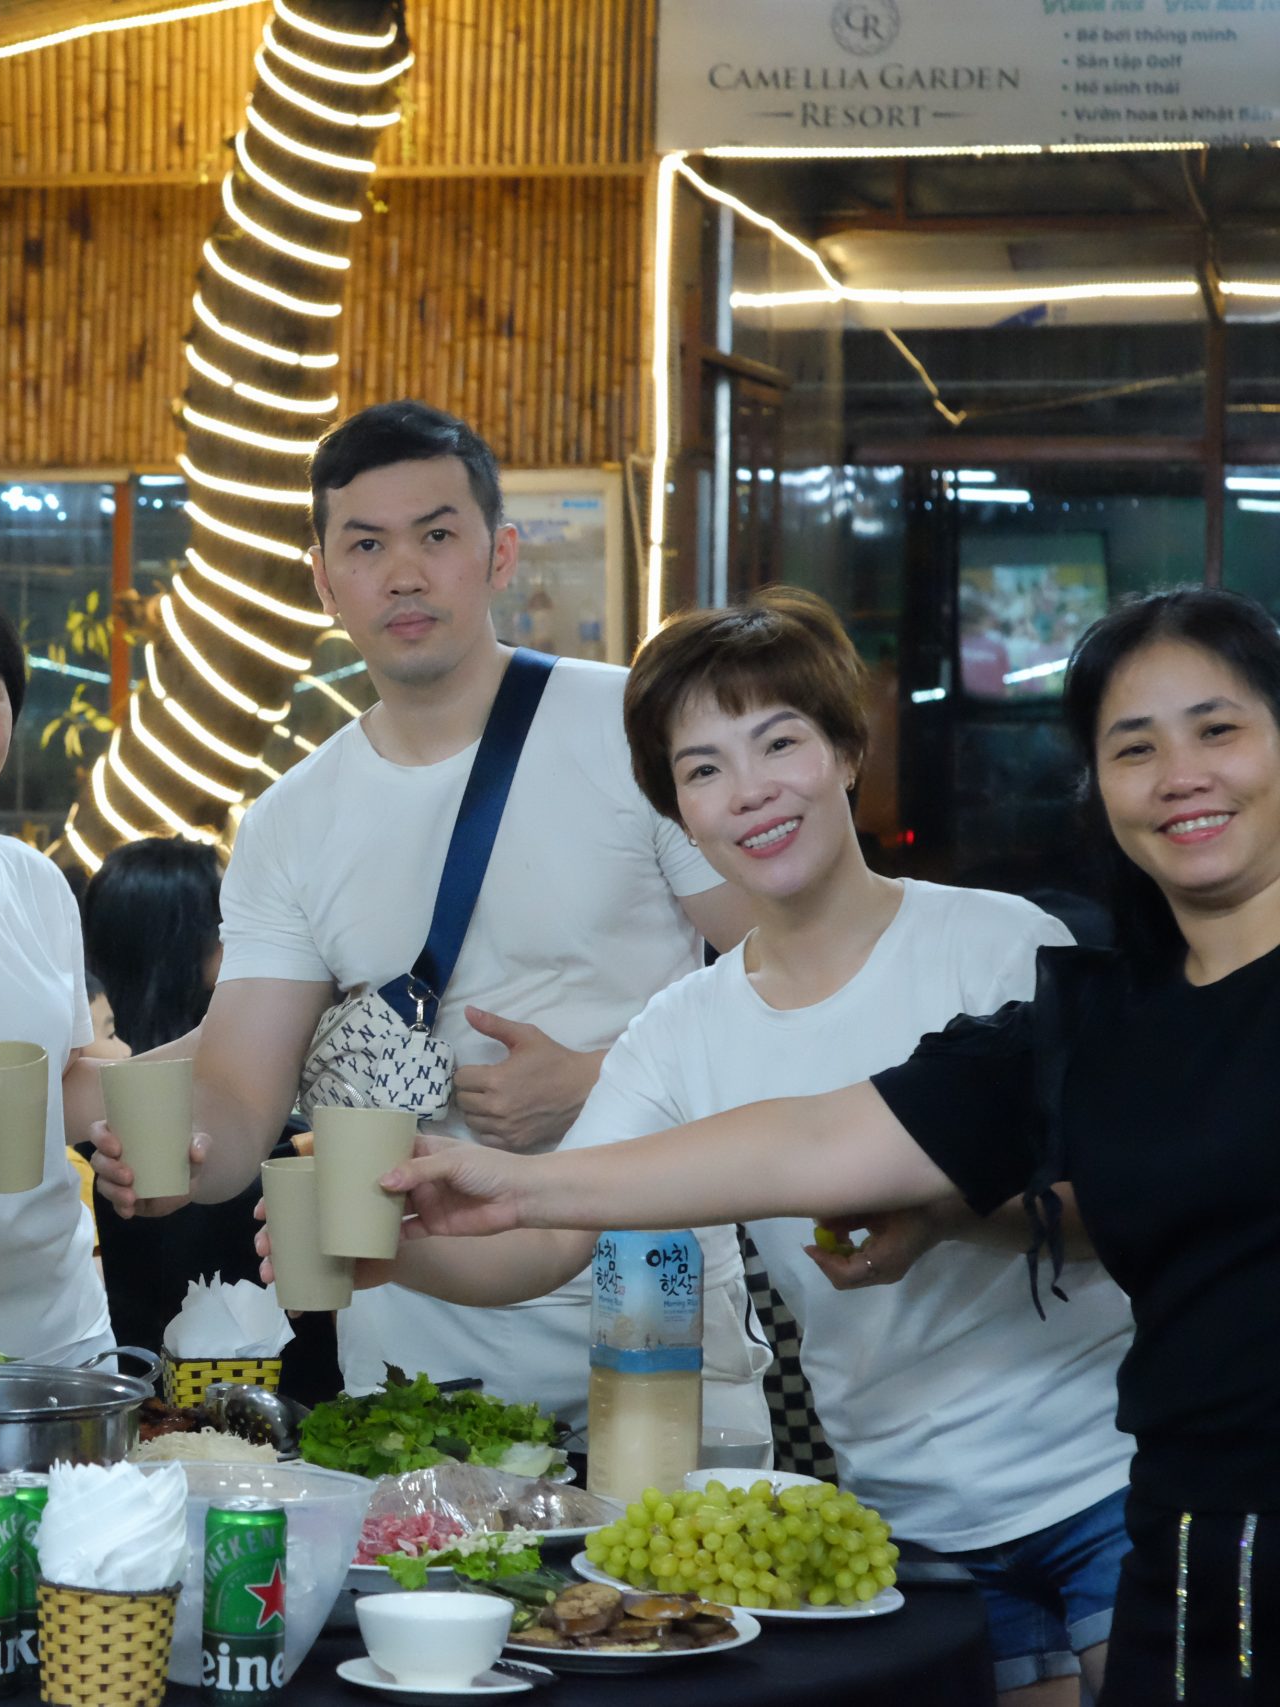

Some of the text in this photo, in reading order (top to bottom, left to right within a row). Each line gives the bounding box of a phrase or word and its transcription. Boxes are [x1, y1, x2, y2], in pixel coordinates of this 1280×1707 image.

[1192, 29, 1237, 42] minh
[1146, 54, 1183, 69] Golf
[708, 63, 1021, 91] CAMELLIA GARDEN
[1104, 80, 1141, 94] sinh
[1145, 80, 1180, 94] thái
[800, 101, 927, 128] RESORT
[1126, 107, 1158, 121] hoa
[645, 1242, 688, 1274] 아침
[596, 1267, 623, 1294] 햇살
[659, 1273, 697, 1296] 햇살
